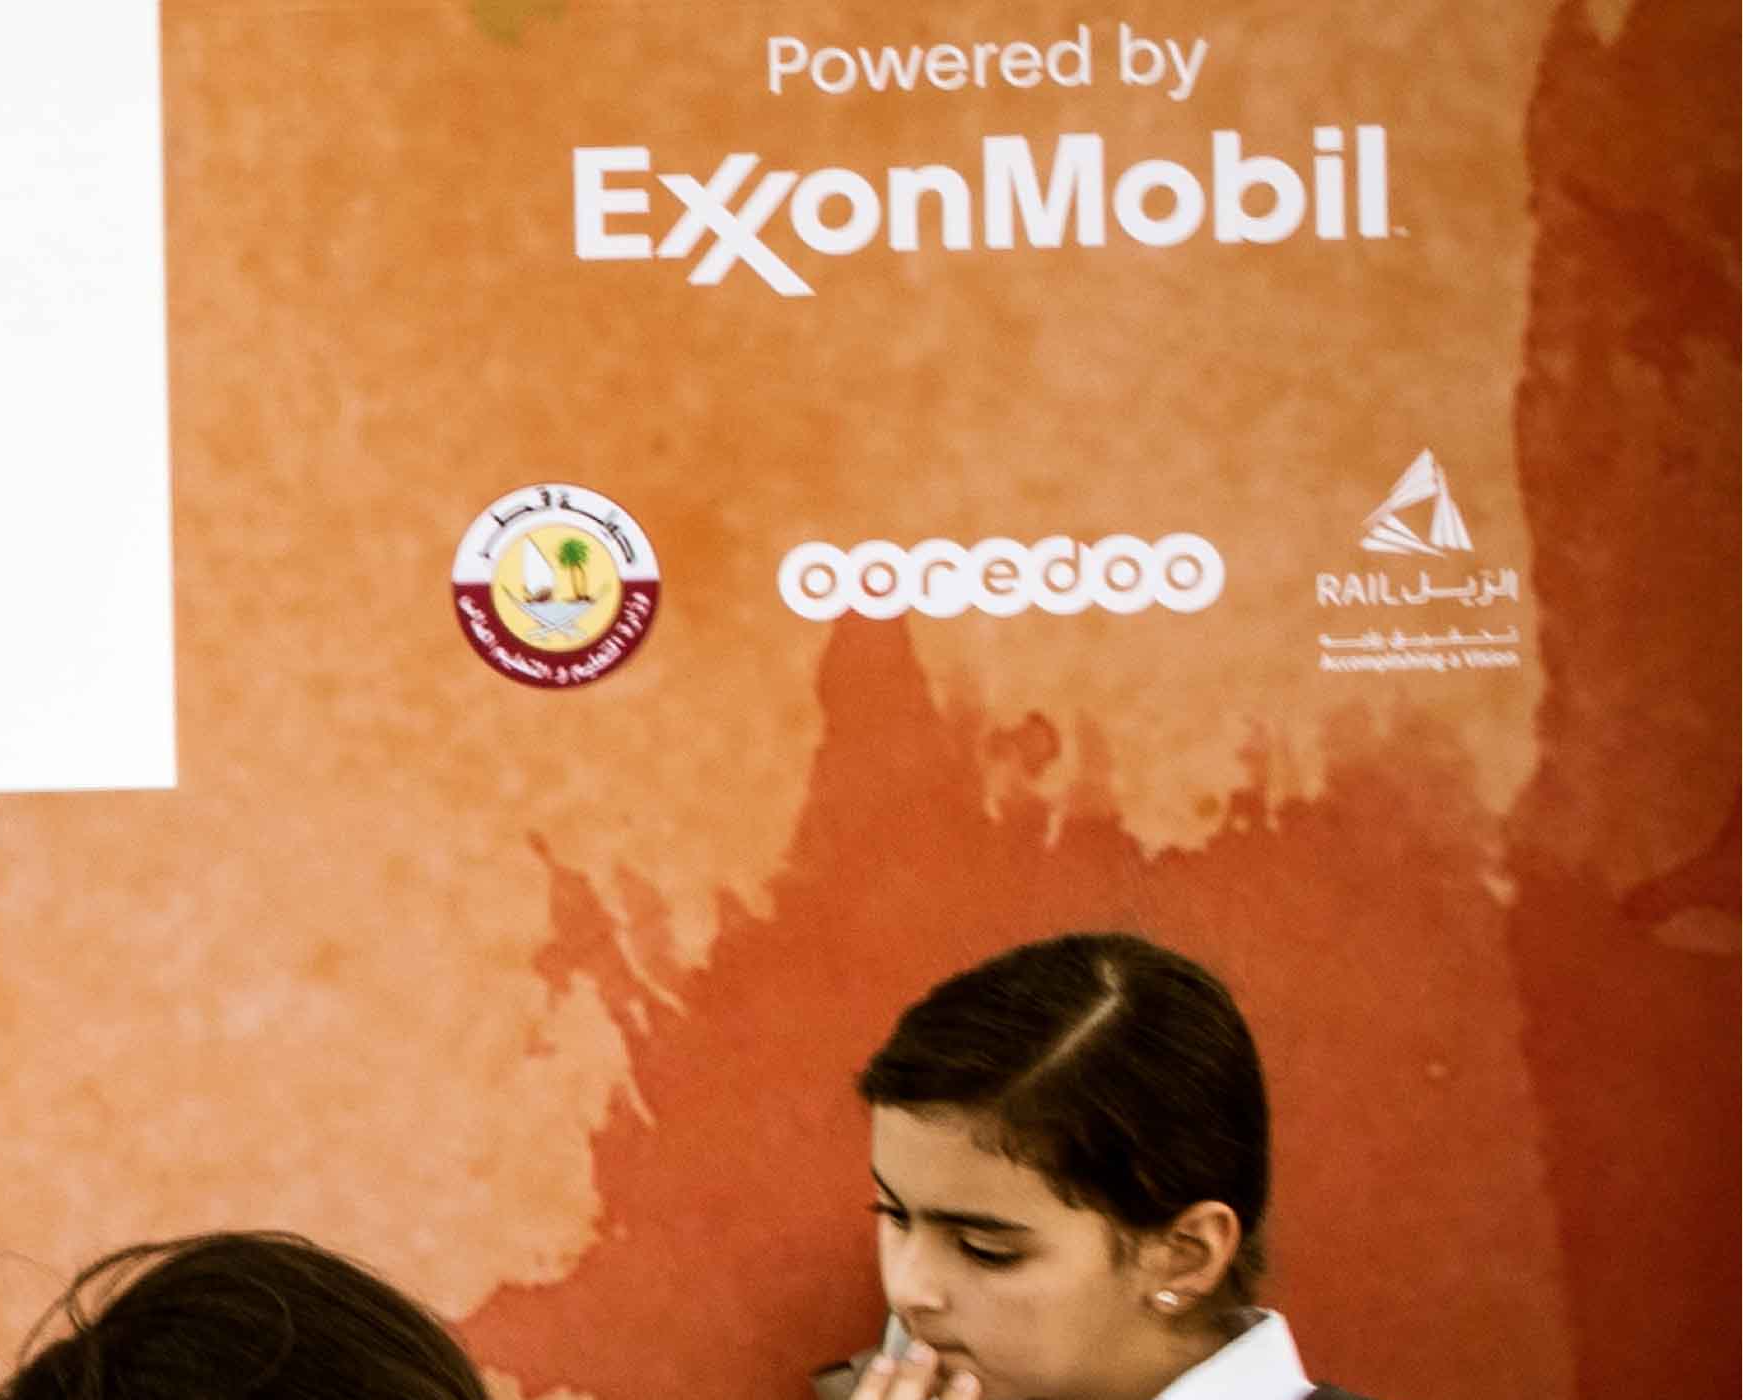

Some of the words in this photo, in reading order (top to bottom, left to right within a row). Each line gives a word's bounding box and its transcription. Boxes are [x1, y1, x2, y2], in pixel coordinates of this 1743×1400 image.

[767, 24, 1093, 95] Powered
[1118, 22, 1209, 101] by
[572, 125, 1391, 297] ExxonMobil
[787, 536, 1215, 612] ooredoo
[1316, 572, 1401, 608] RAIL
